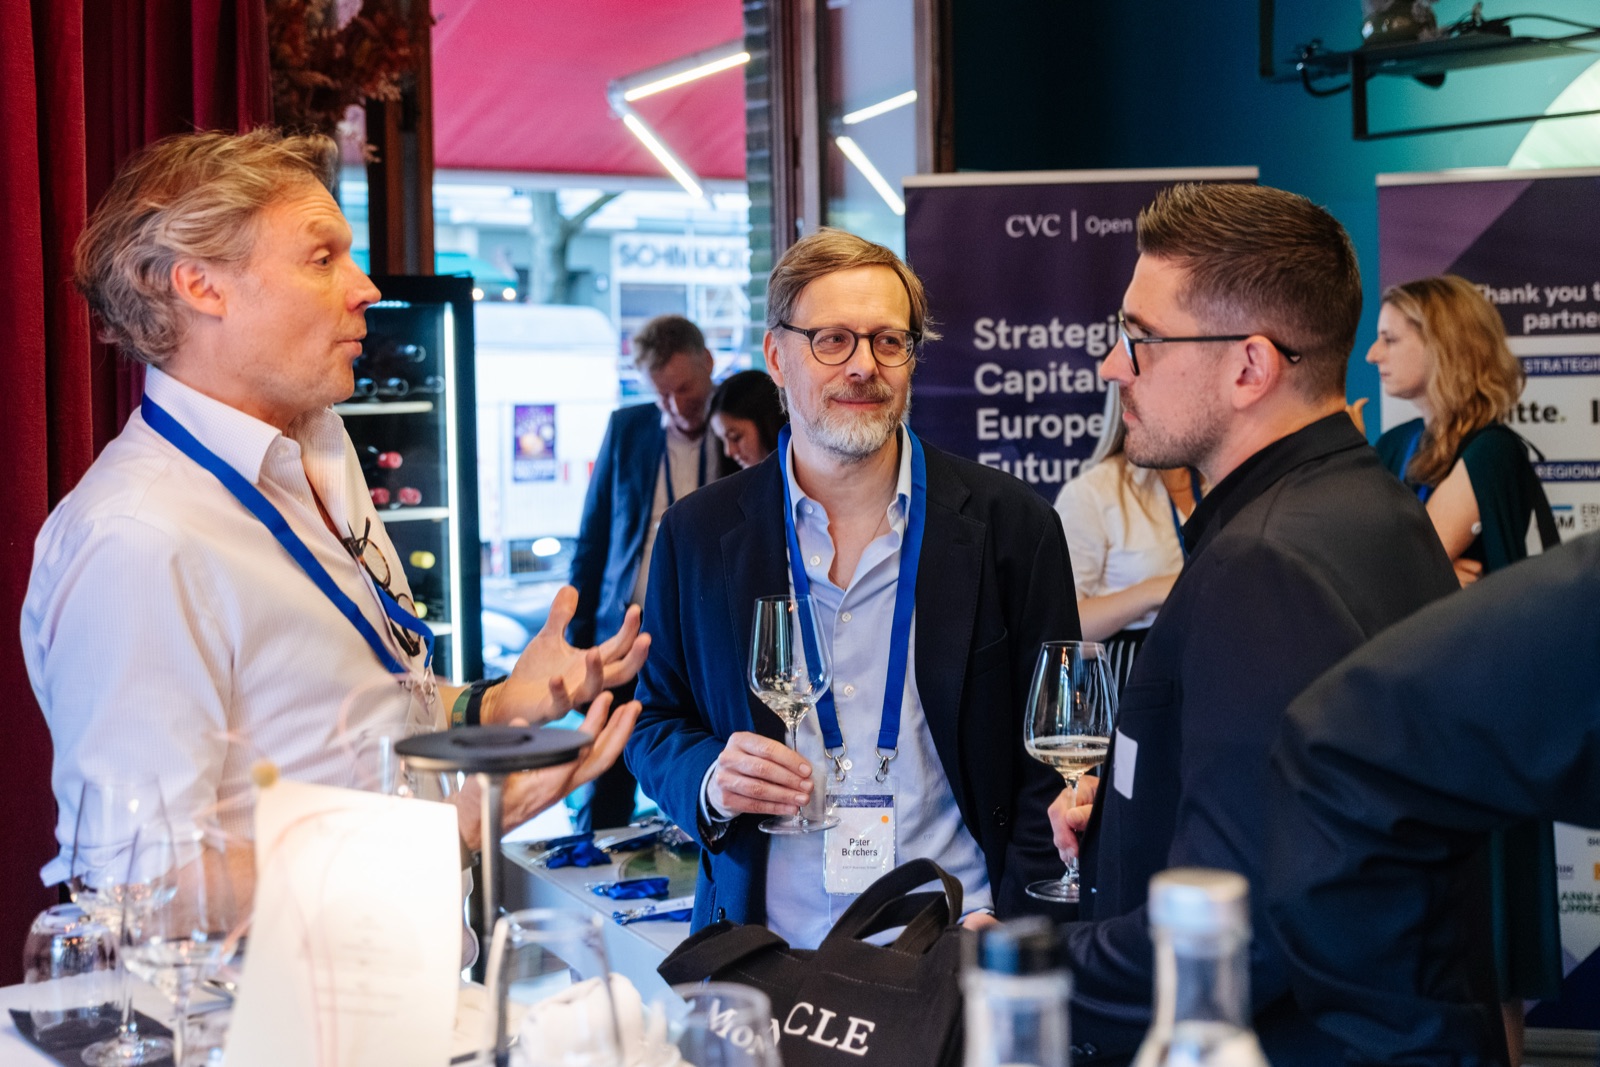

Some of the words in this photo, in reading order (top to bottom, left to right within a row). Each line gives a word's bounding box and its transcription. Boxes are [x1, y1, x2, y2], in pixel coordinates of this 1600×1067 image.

[1005, 214, 1061, 238] CVC
[1084, 215, 1133, 238] Open
[1544, 285, 1587, 308] you
[973, 315, 1120, 357] Strategi
[1523, 309, 1600, 335] partne
[1523, 357, 1600, 374] STRATEGI
[974, 362, 1108, 403] Capital
[976, 408, 1105, 447] Europe
[978, 452, 1091, 484] Futur
